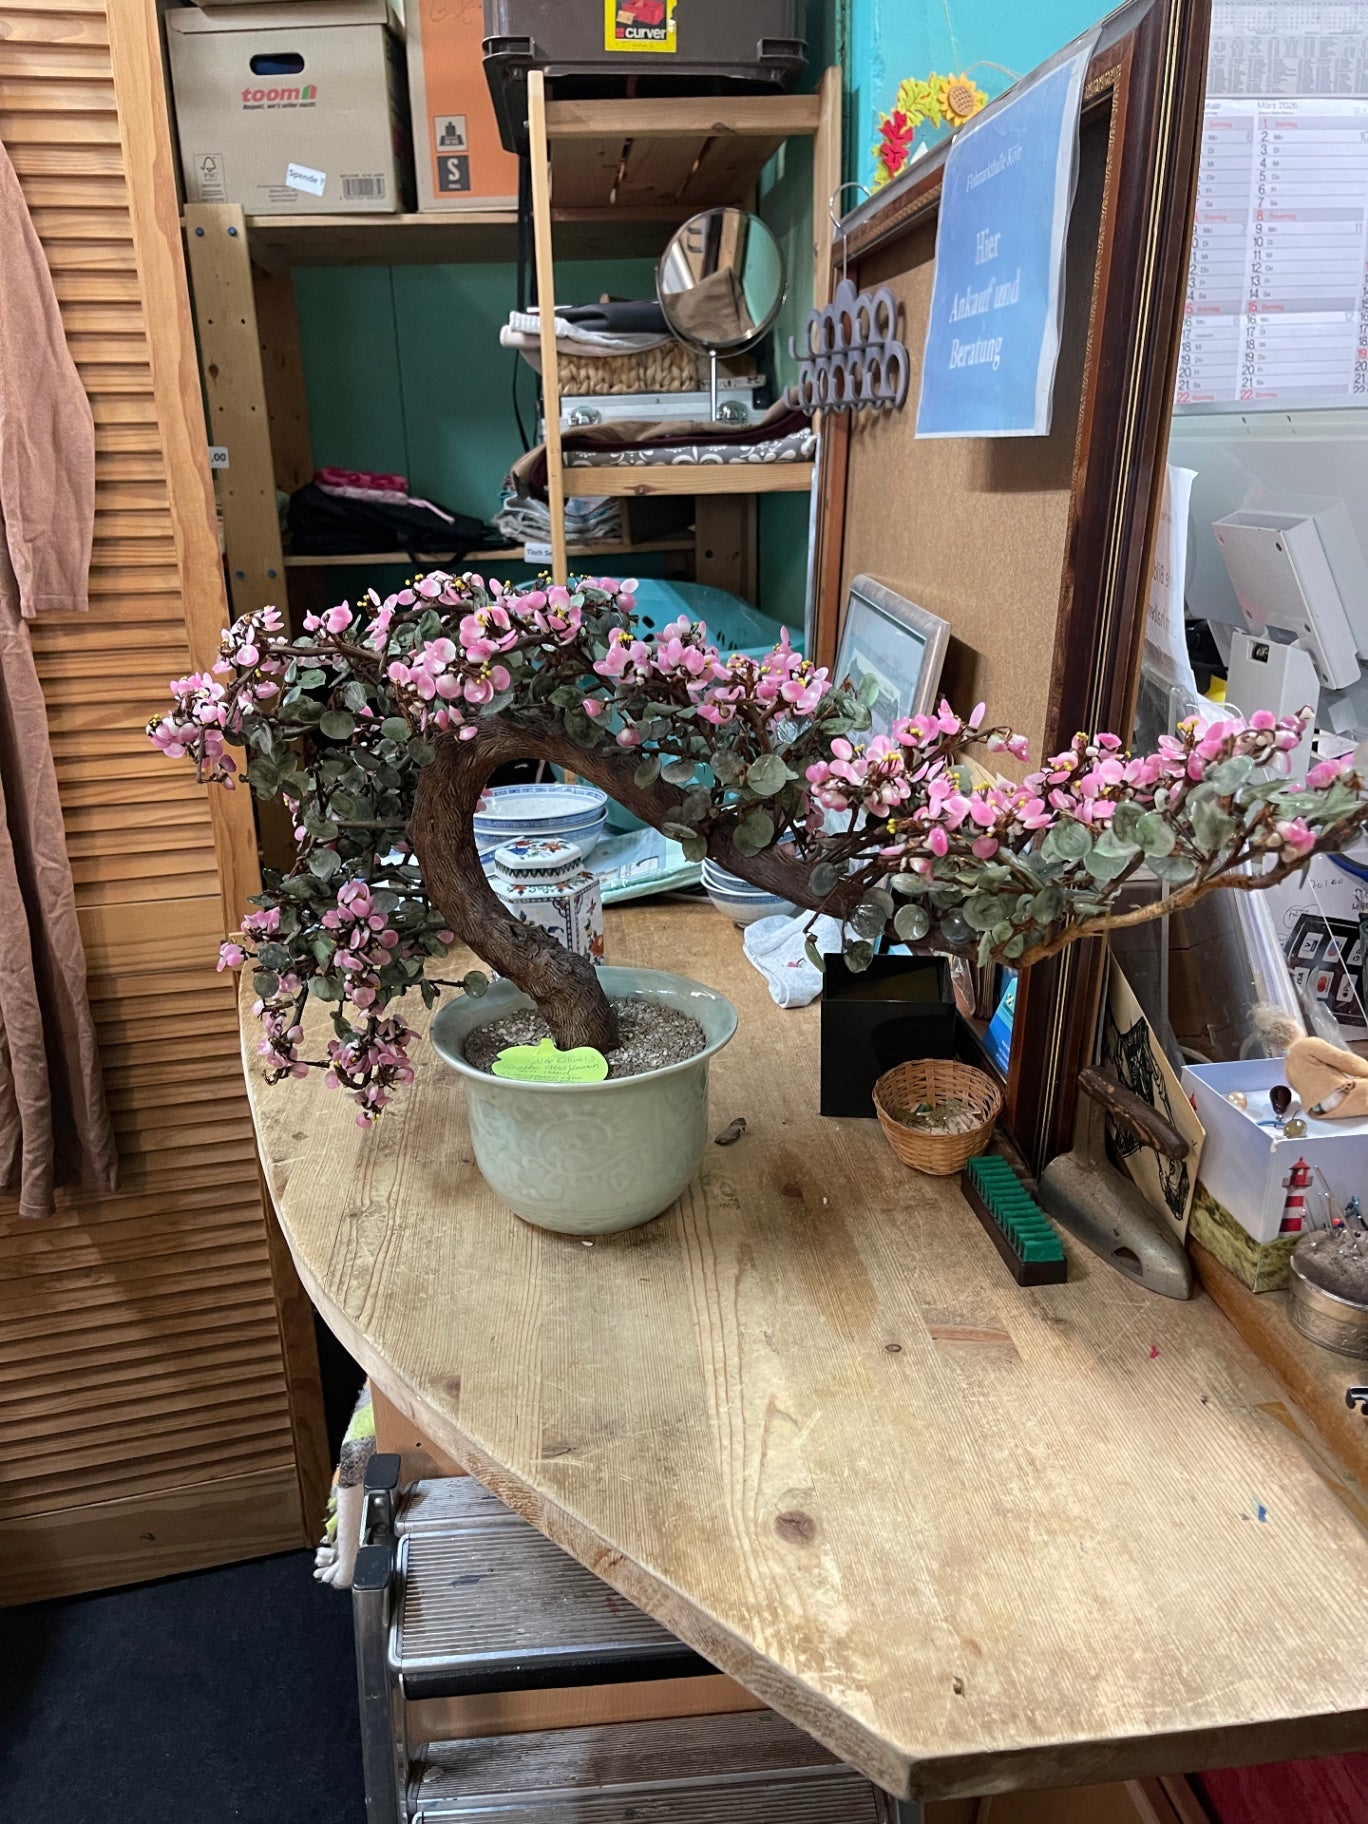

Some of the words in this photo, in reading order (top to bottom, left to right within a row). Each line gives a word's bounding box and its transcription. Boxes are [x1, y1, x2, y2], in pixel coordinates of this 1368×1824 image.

[625, 27, 667, 39] curver
[241, 88, 300, 102] toom
[1263, 119, 1268, 129] 1
[1261, 131, 1269, 142] 2
[1260, 144, 1268, 155] 3
[1260, 158, 1266, 168] 4
[447, 158, 460, 180] S
[1259, 171, 1266, 182] 5
[1258, 183, 1266, 195] 6
[1257, 197, 1264, 208] 7
[1256, 209, 1264, 221] 8
[1255, 223, 1262, 235] 9
[975, 227, 1001, 266] Hier
[1254, 236, 1264, 248] 10
[1253, 250, 1262, 260] 11
[1252, 262, 1262, 273] 12
[1251, 275, 1260, 287] 13
[949, 276, 996, 323] Ankauf
[994, 267, 1020, 309] und
[1250, 288, 1259, 299] 14
[1248, 301, 1258, 313] 15
[1247, 313, 1257, 325] 16
[1246, 326, 1256, 338] 17
[1246, 339, 1256, 350] 18
[949, 336, 1003, 371] Beratung
[1245, 352, 1255, 363] 19
[1358, 349, 1367, 359] 19
[1242, 364, 1255, 376] 20
[1355, 361, 1367, 372] 20
[1242, 376, 1253, 388] 21
[1354, 373, 1366, 384] 21
[1240, 389, 1253, 400] 22
[210, 452, 227, 463] ,00
